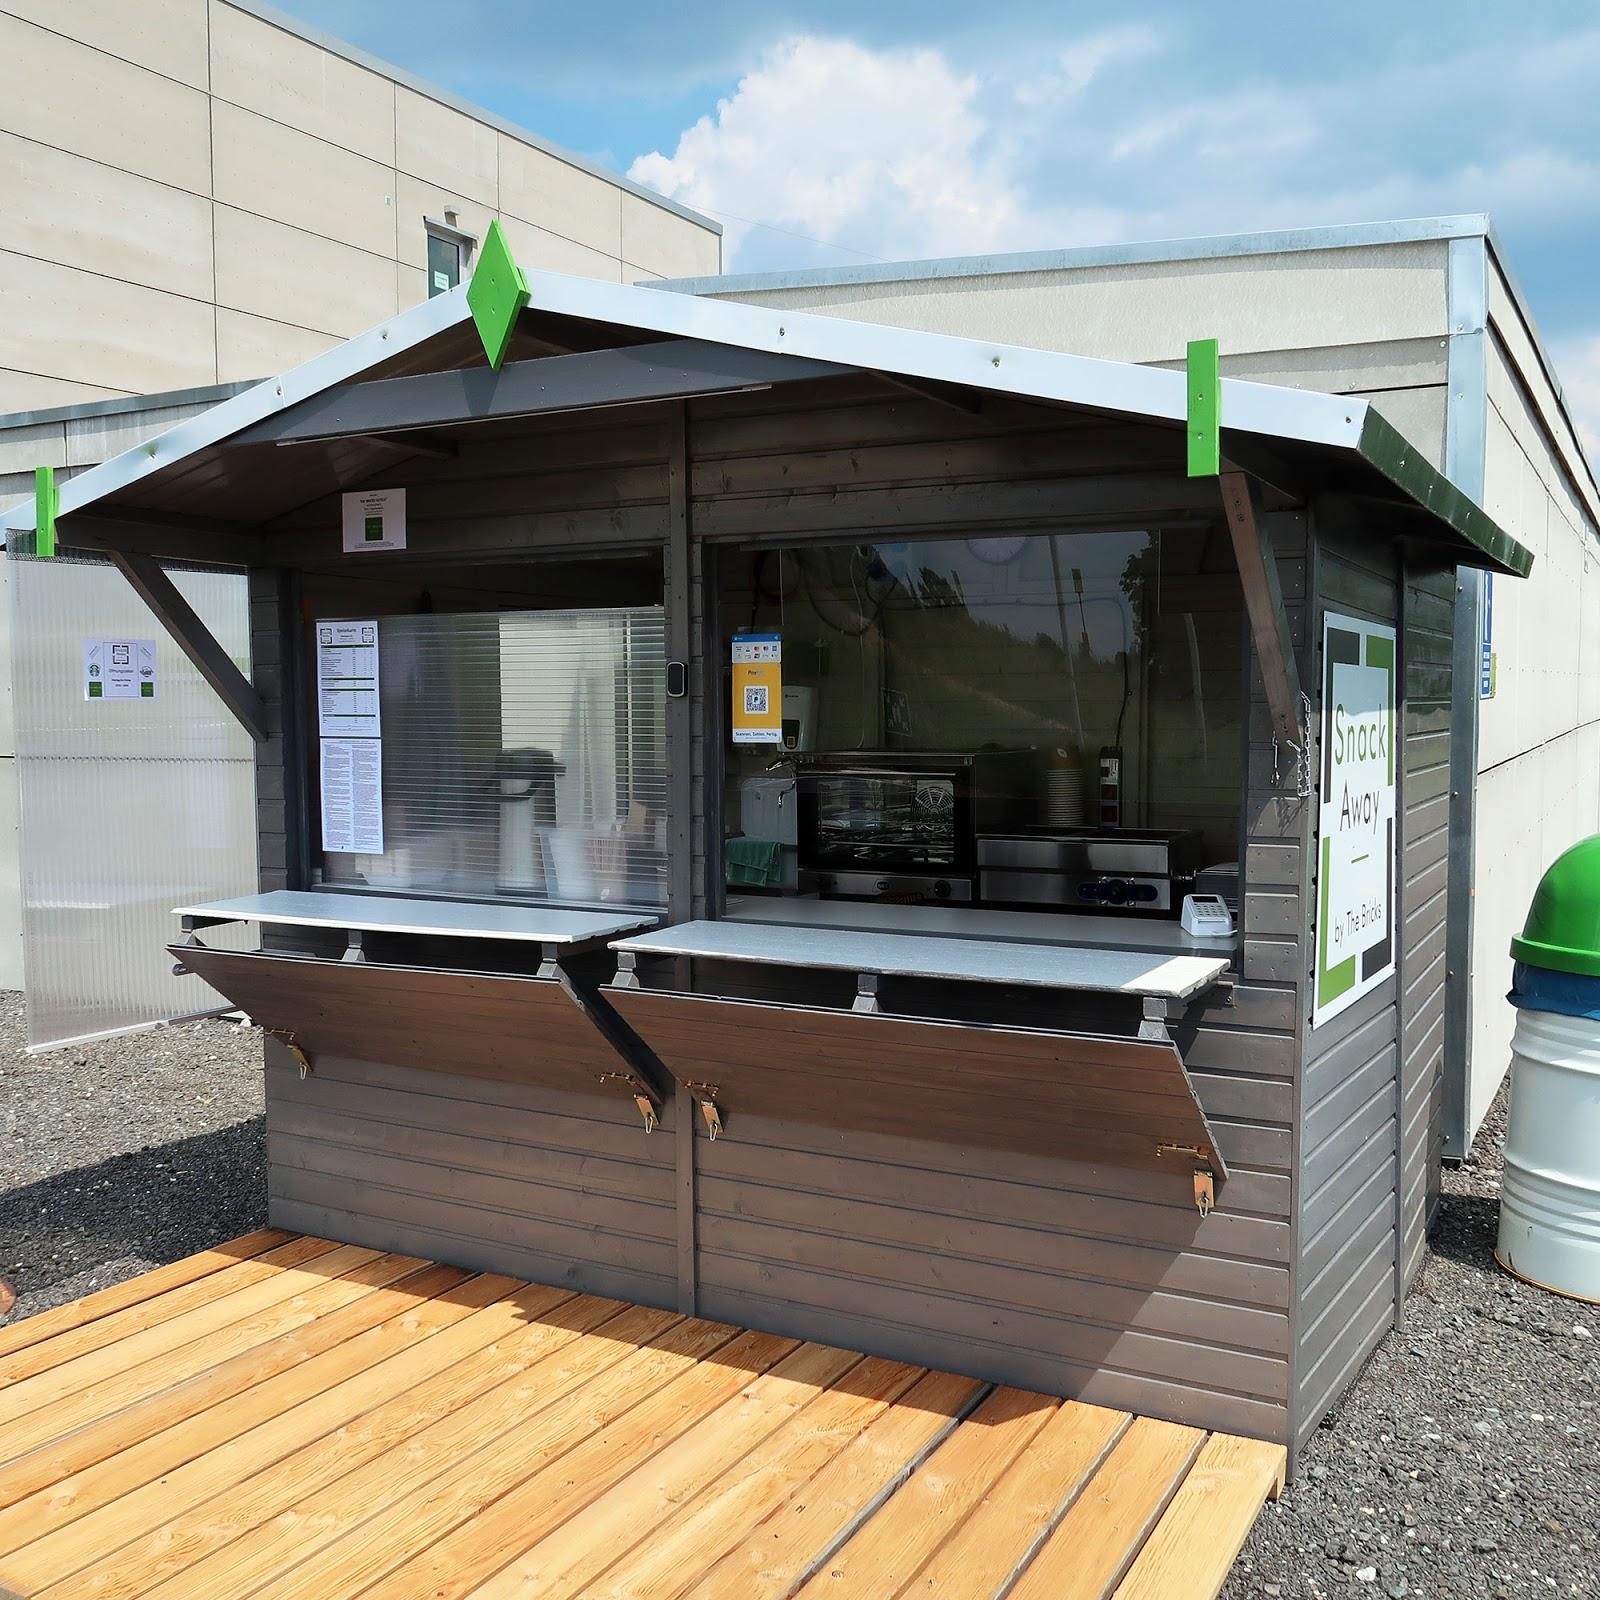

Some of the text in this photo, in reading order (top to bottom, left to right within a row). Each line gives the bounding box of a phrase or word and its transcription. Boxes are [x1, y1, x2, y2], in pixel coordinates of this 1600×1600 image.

[1335, 703, 1386, 765] Snack
[1340, 778, 1380, 835] Away
[1334, 896, 1382, 948] by The Bricks
